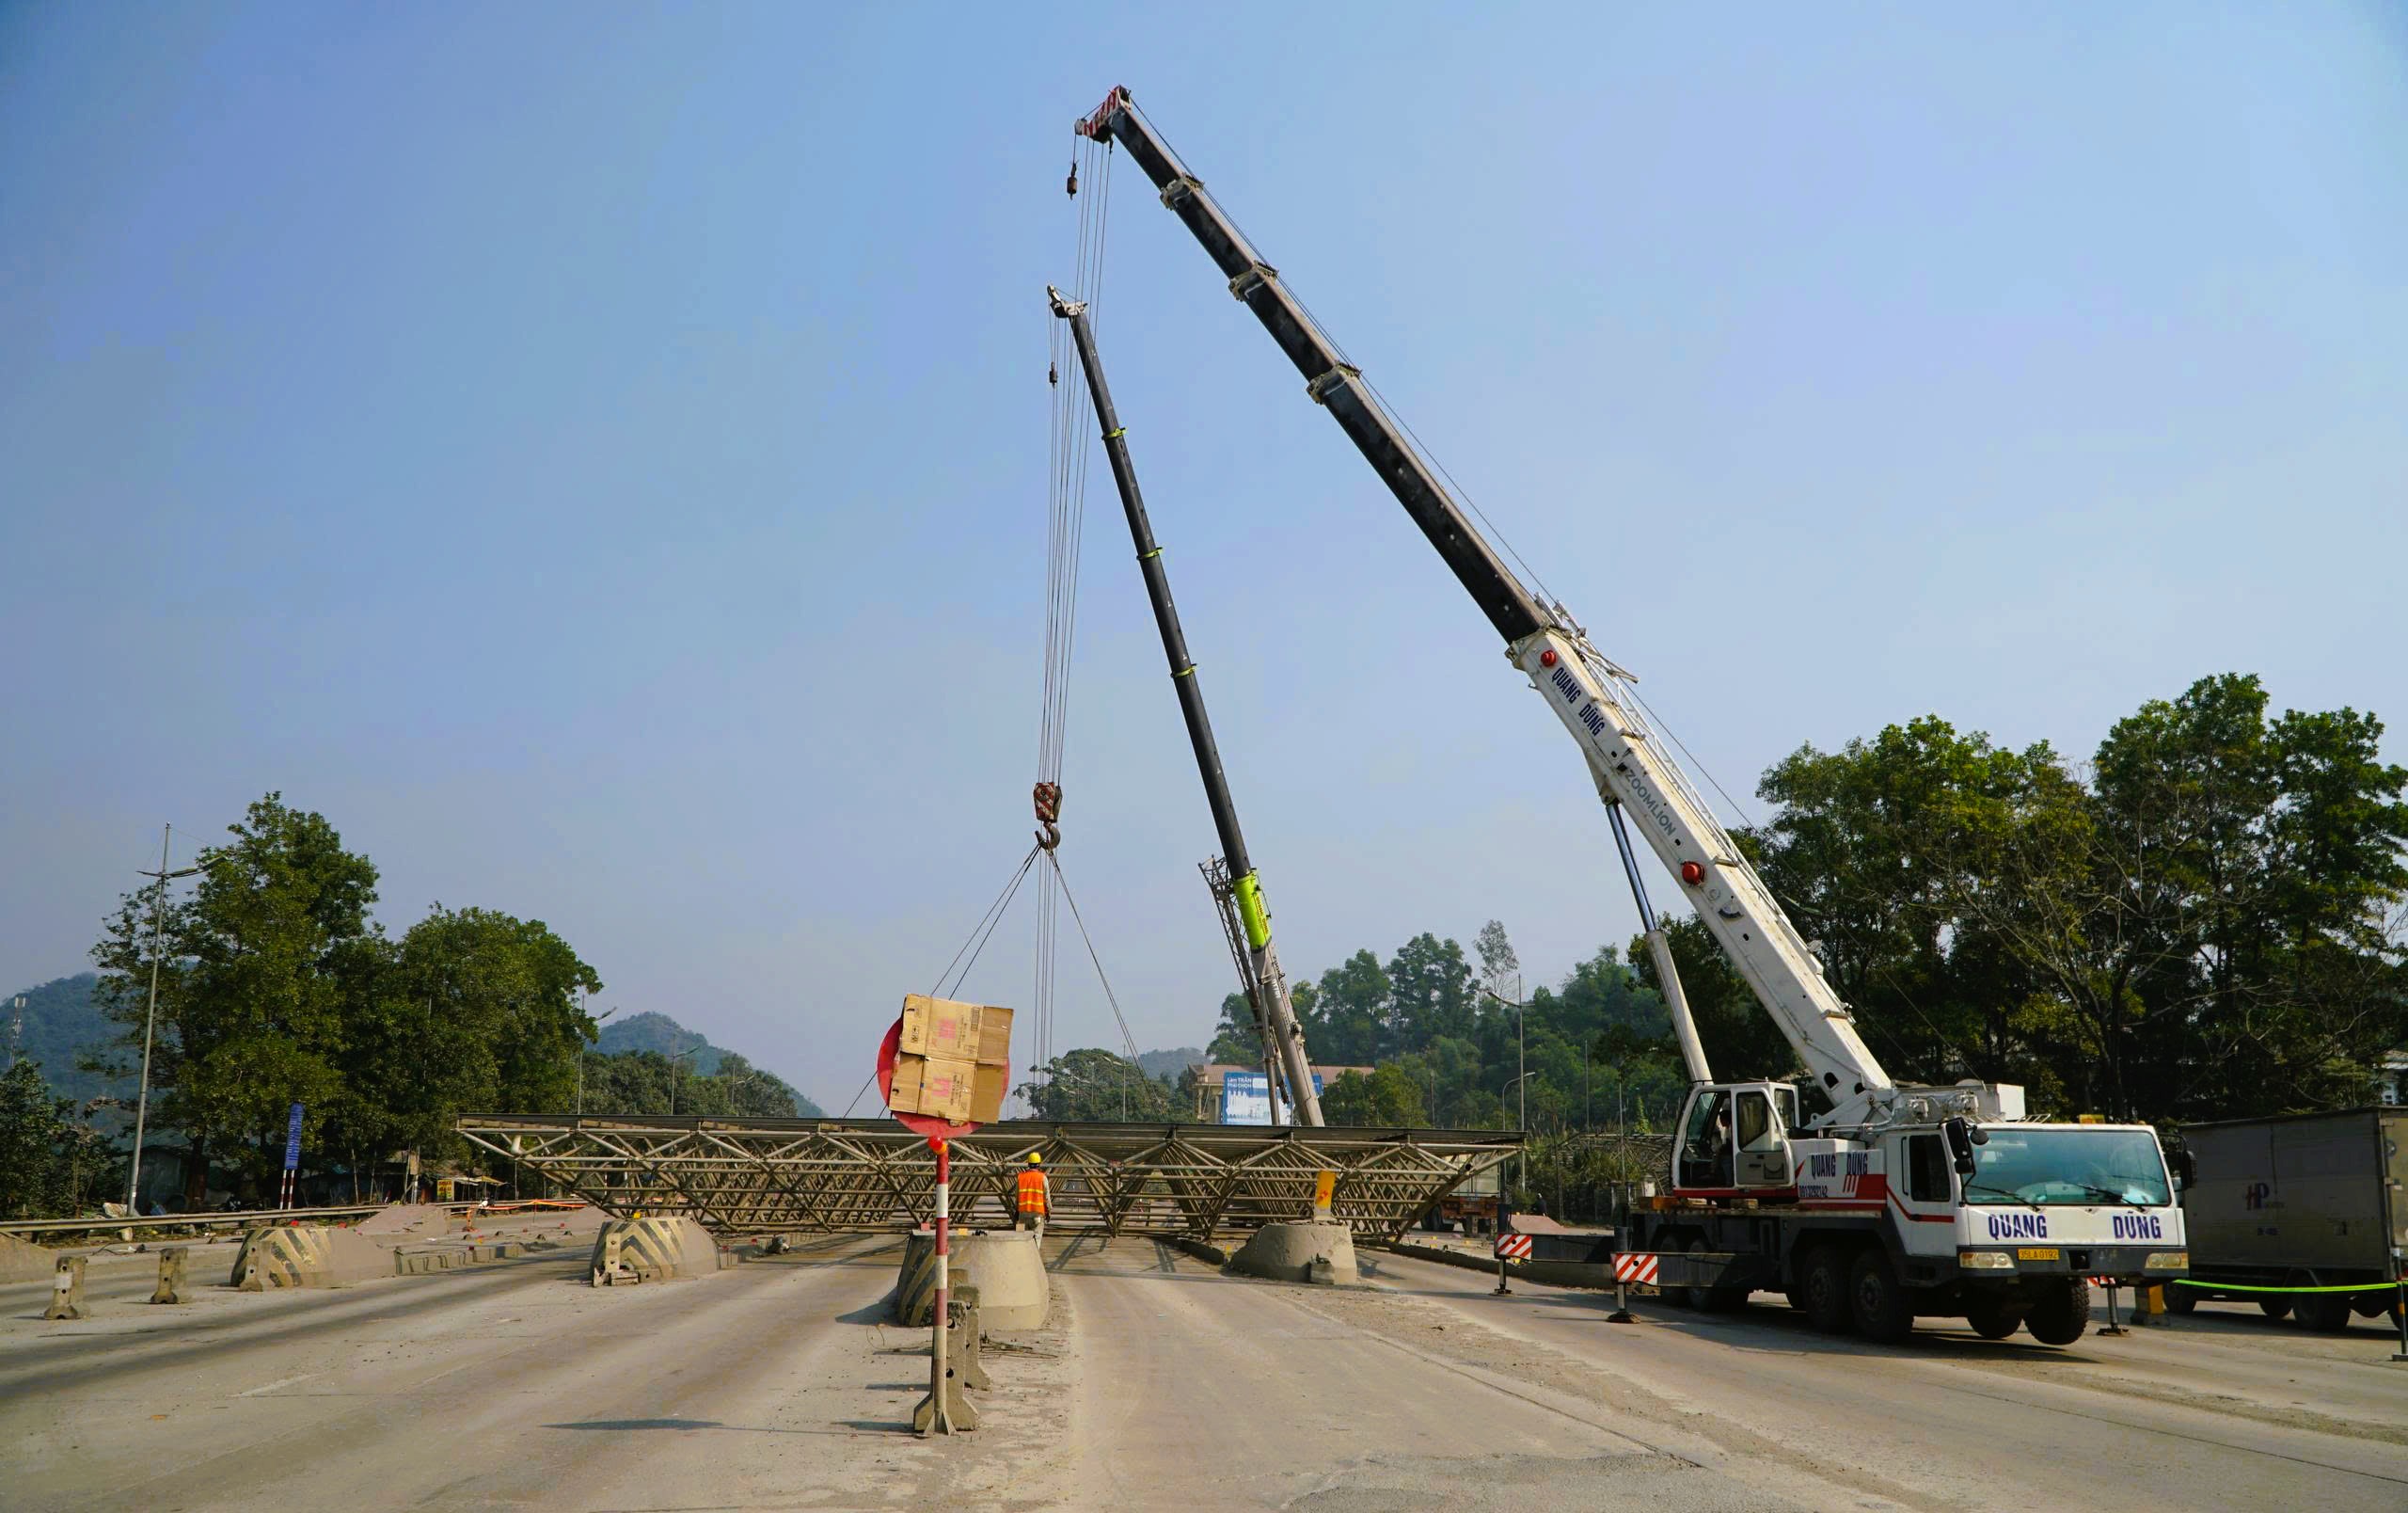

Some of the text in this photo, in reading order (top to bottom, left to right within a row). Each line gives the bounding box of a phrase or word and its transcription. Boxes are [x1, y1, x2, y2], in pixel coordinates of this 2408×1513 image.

[1552, 666, 1581, 704] QUANG
[1625, 770, 1675, 836] ZOOMLION
[1811, 1155, 1836, 1179] QUANG
[1988, 1210, 2162, 1240] QUANG DŨNG
